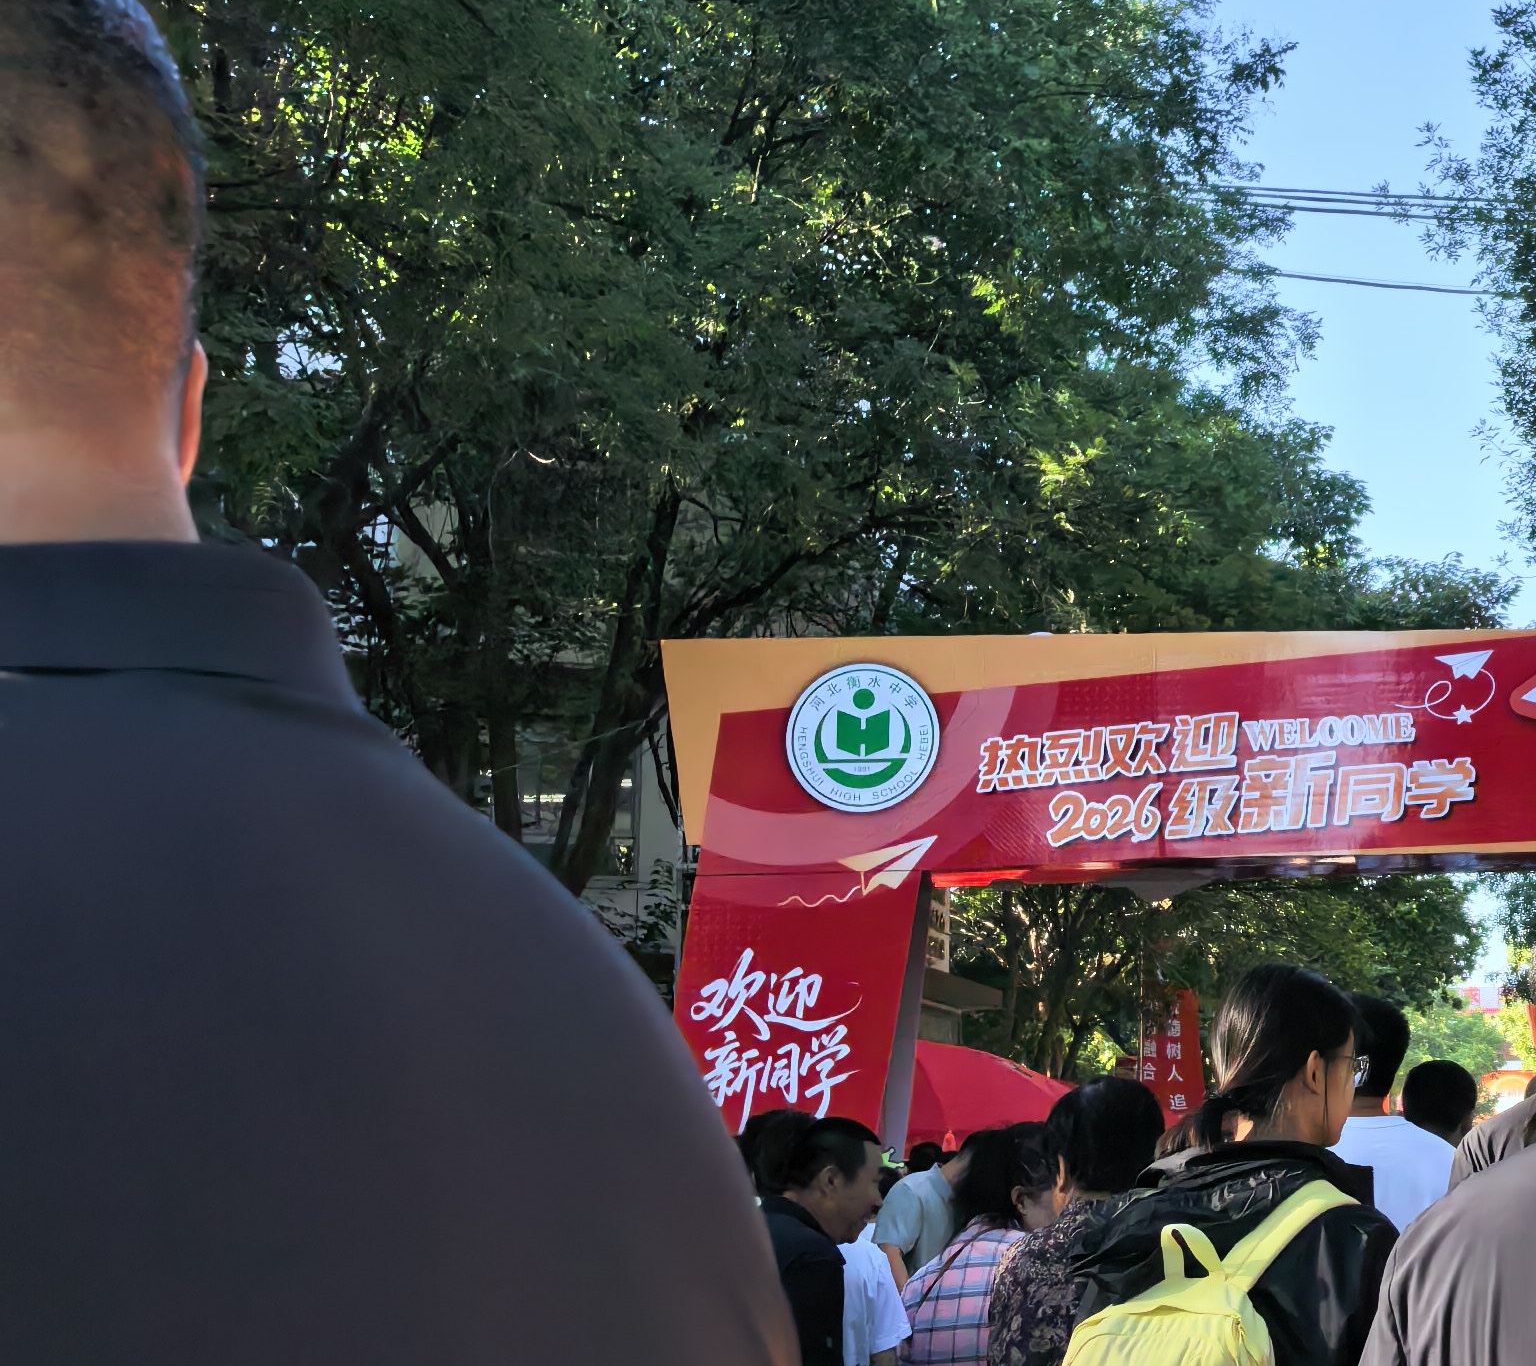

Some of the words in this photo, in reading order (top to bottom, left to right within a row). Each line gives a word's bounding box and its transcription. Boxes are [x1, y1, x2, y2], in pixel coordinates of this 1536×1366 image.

[808, 675, 919, 712] 河北衡水中学
[797, 726, 825, 787] HENGSHUI
[830, 787, 861, 802] HIGH
[872, 770, 919, 800] SCHOOL
[917, 724, 929, 761] HEBEI
[976, 712, 1239, 793] 热烈欢迎
[1242, 713, 1416, 752] WELCOME
[1046, 751, 1476, 847] 2026级新同学
[690, 947, 863, 1041] 欢迎
[703, 1024, 862, 1135] 新同学
